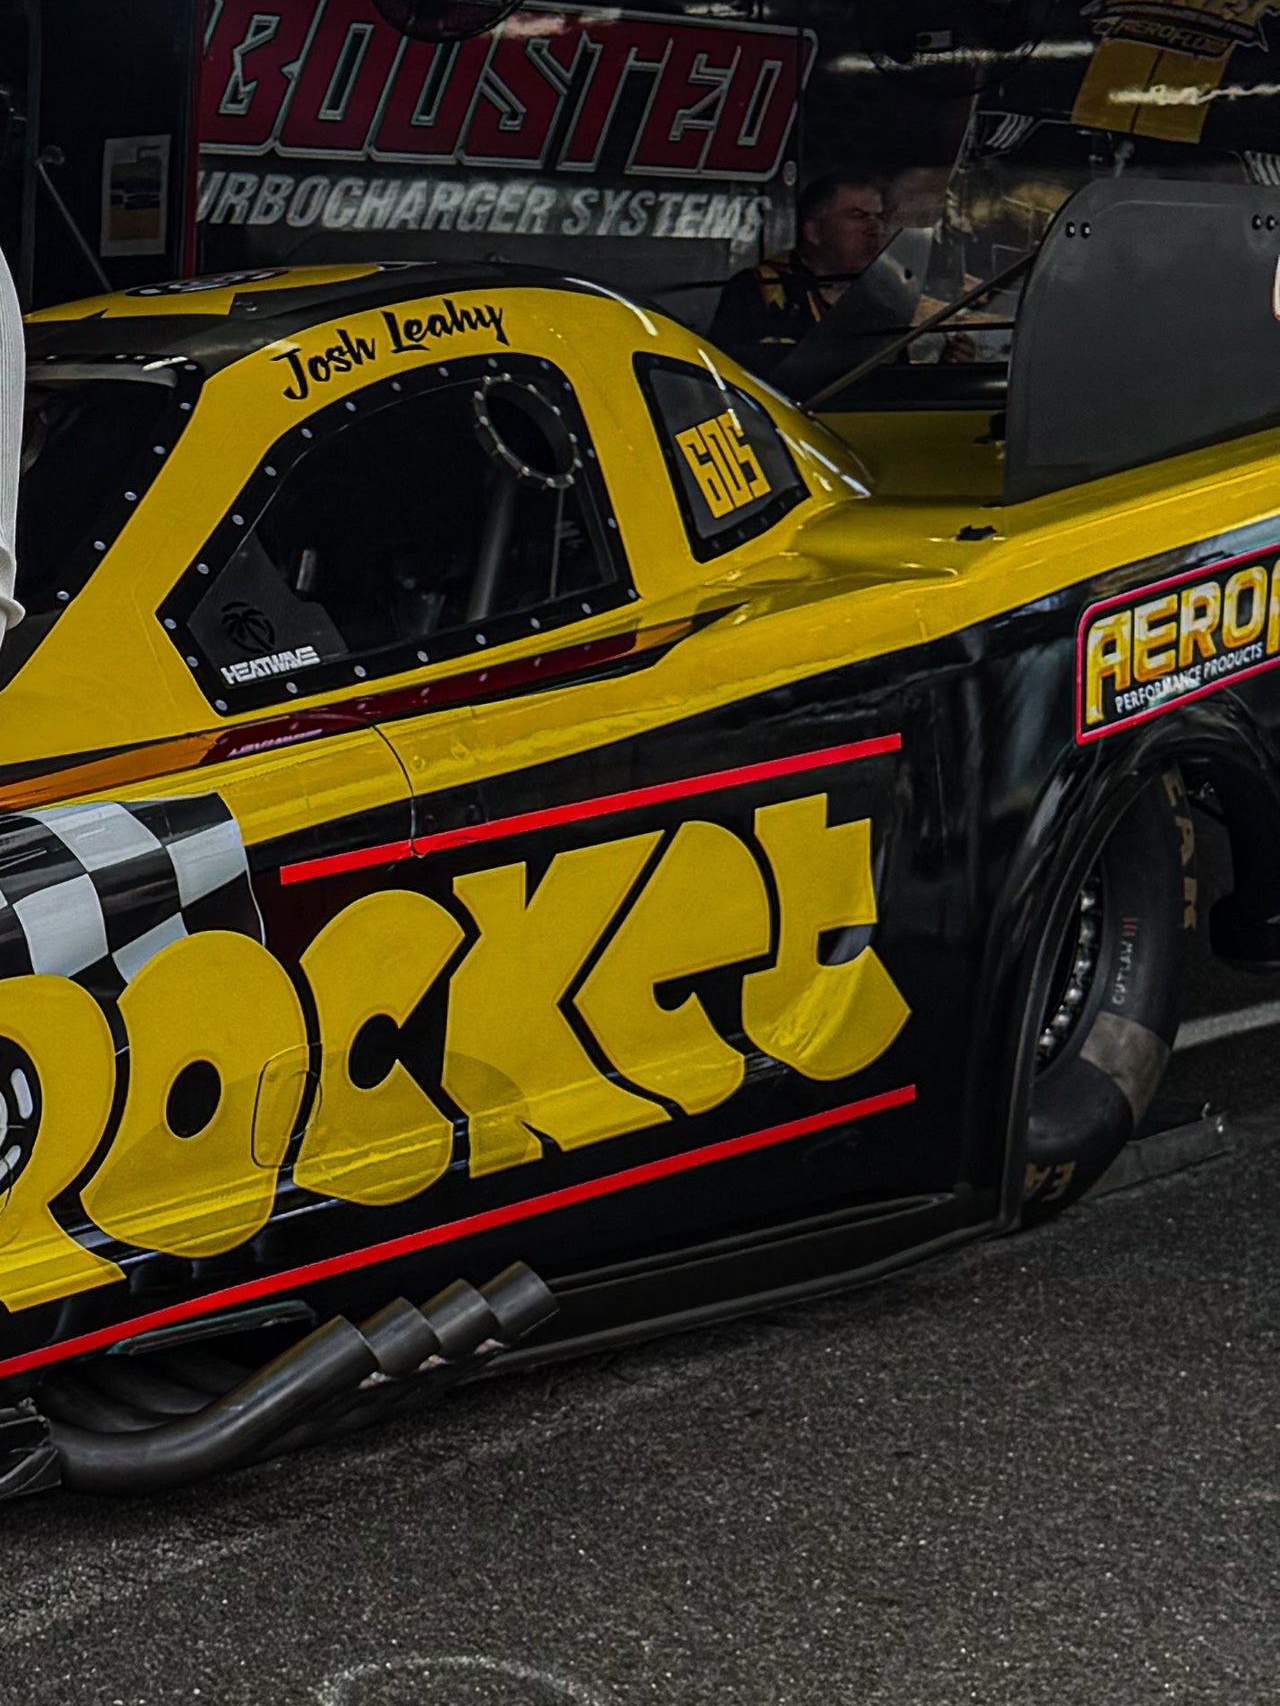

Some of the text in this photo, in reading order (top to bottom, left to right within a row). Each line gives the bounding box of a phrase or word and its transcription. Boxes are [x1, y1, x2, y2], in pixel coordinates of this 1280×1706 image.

[195, 171, 774, 251] URBOCHARGER SYSTEMS
[269, 298, 505, 400] Josh Leahy
[219, 645, 321, 686] HEATWAVE
[1114, 641, 1264, 714] PERFORMANCE PRODUCTS
